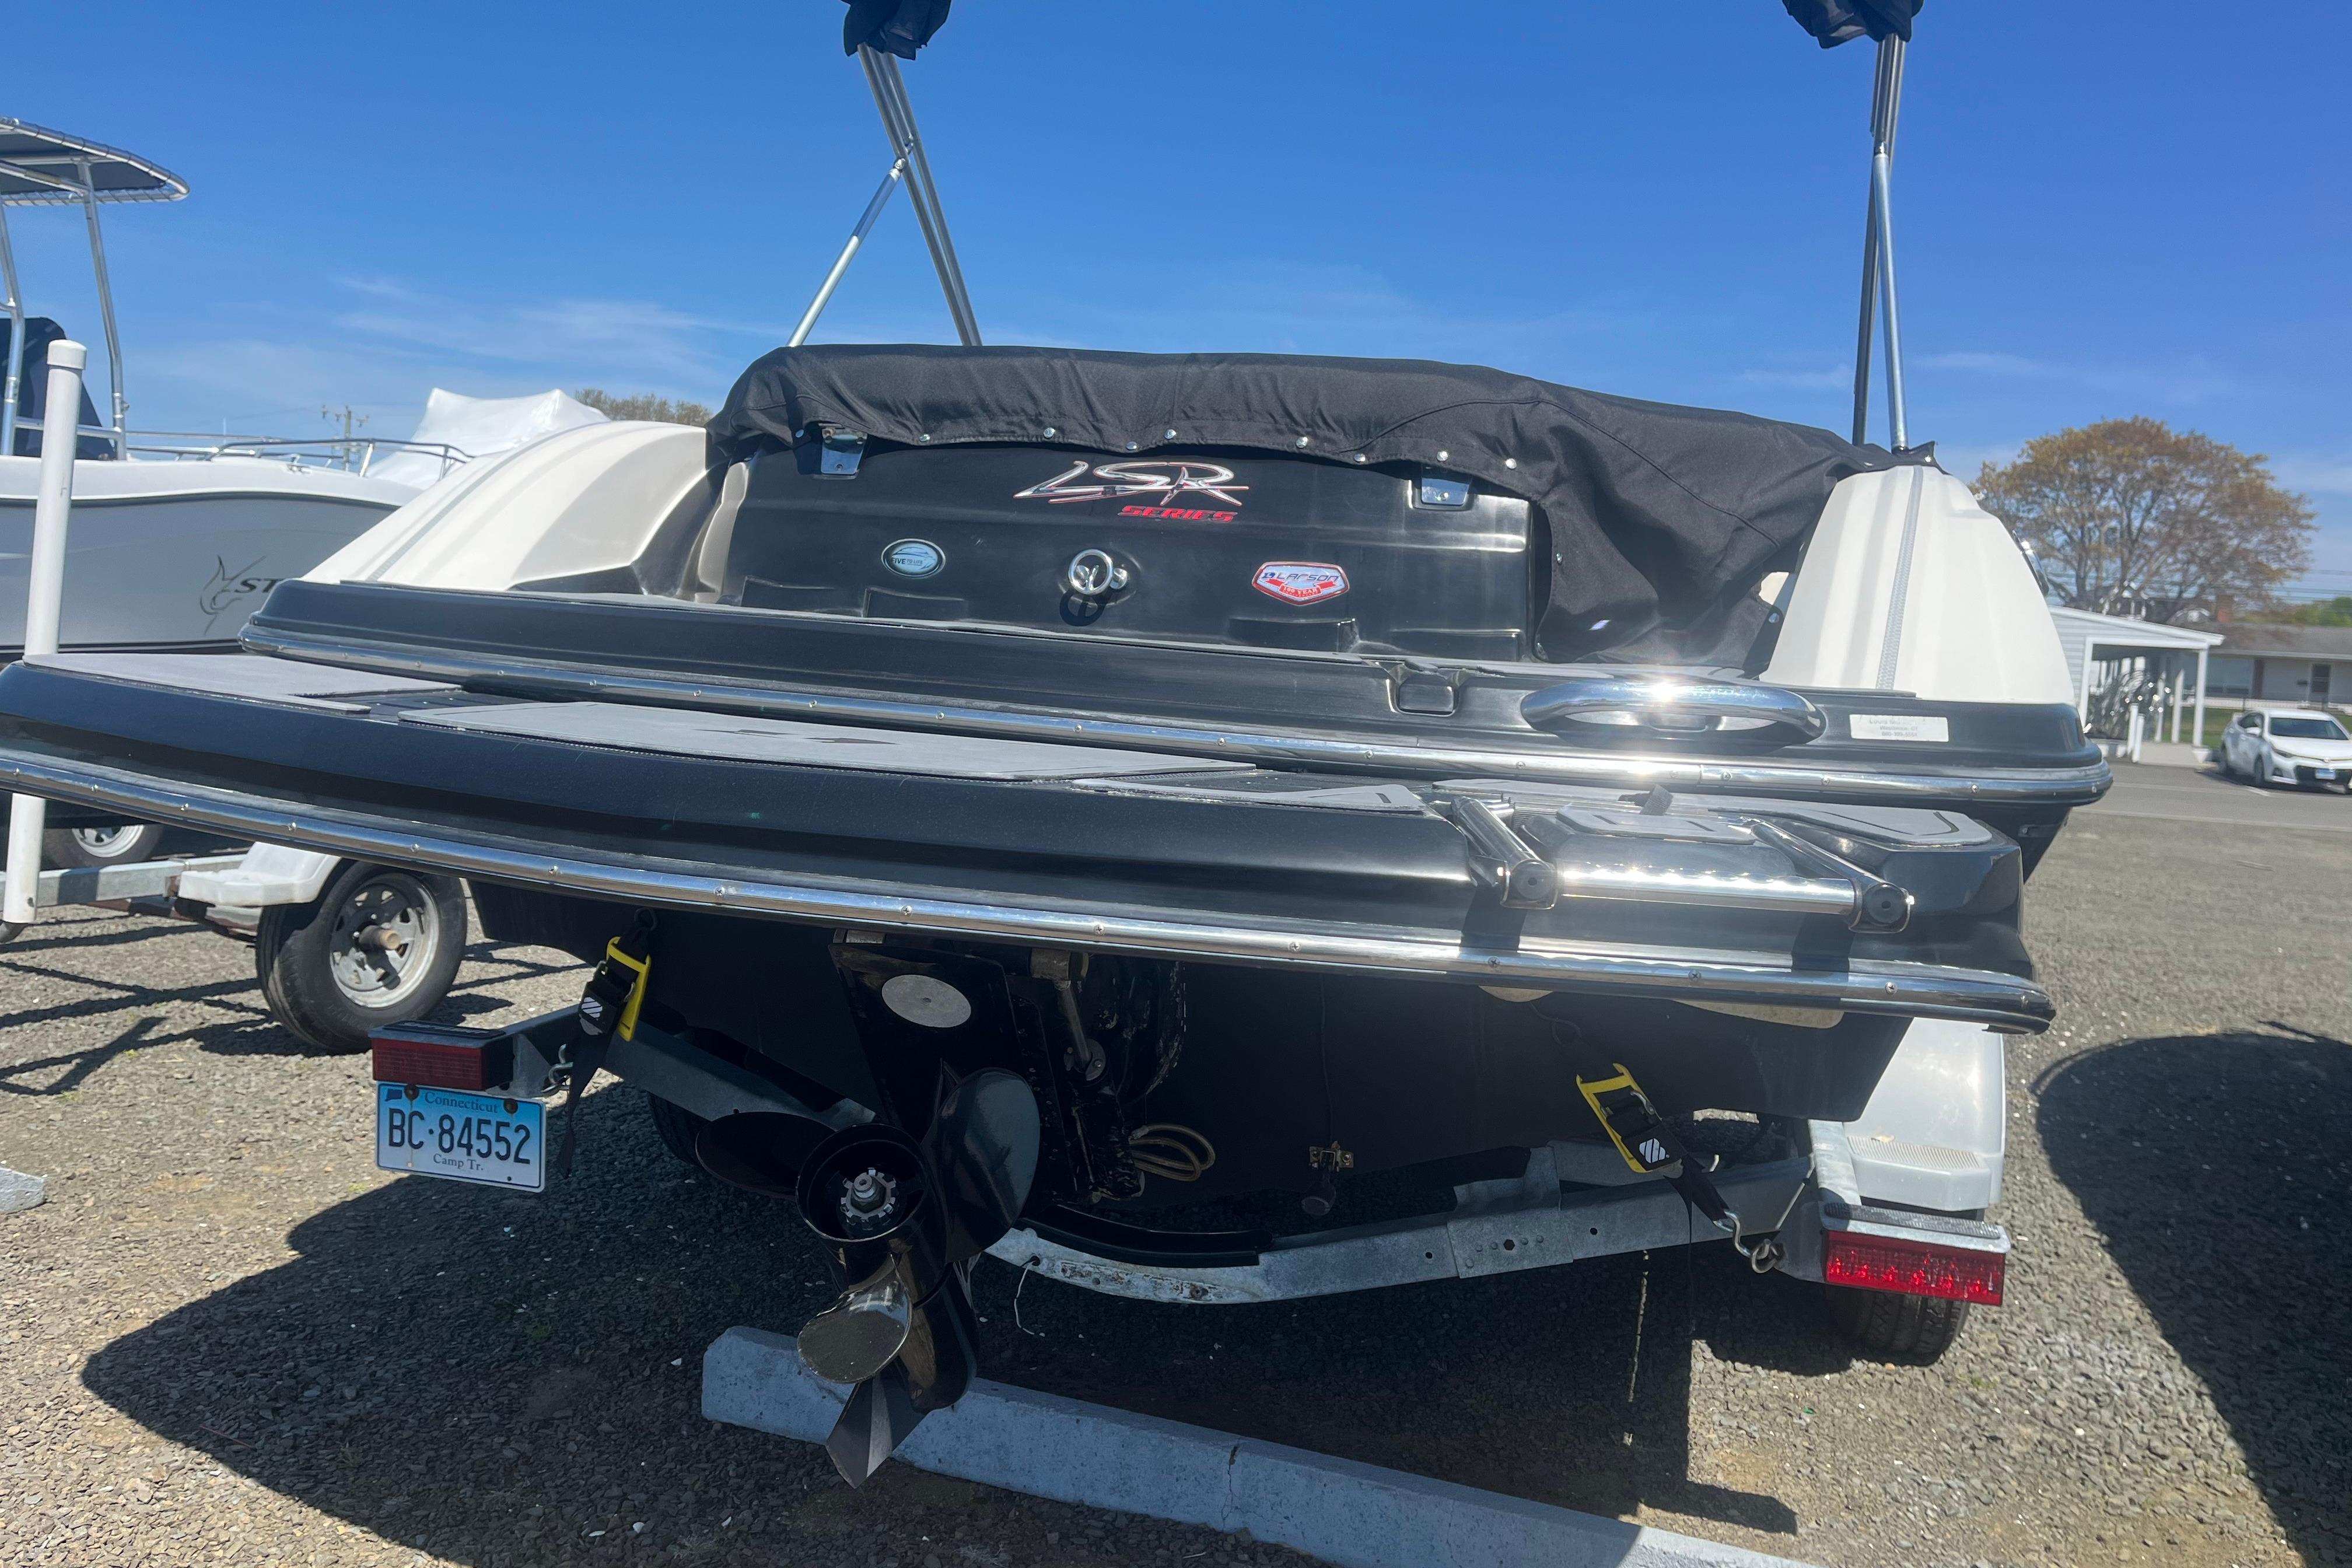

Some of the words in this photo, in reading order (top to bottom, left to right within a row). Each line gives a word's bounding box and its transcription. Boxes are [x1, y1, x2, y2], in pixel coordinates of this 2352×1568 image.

[1118, 506, 1238, 522] SERIES
[425, 1092, 498, 1114] Connecticut
[433, 1153, 464, 1170] Camp
[466, 1158, 484, 1171] Tr.
